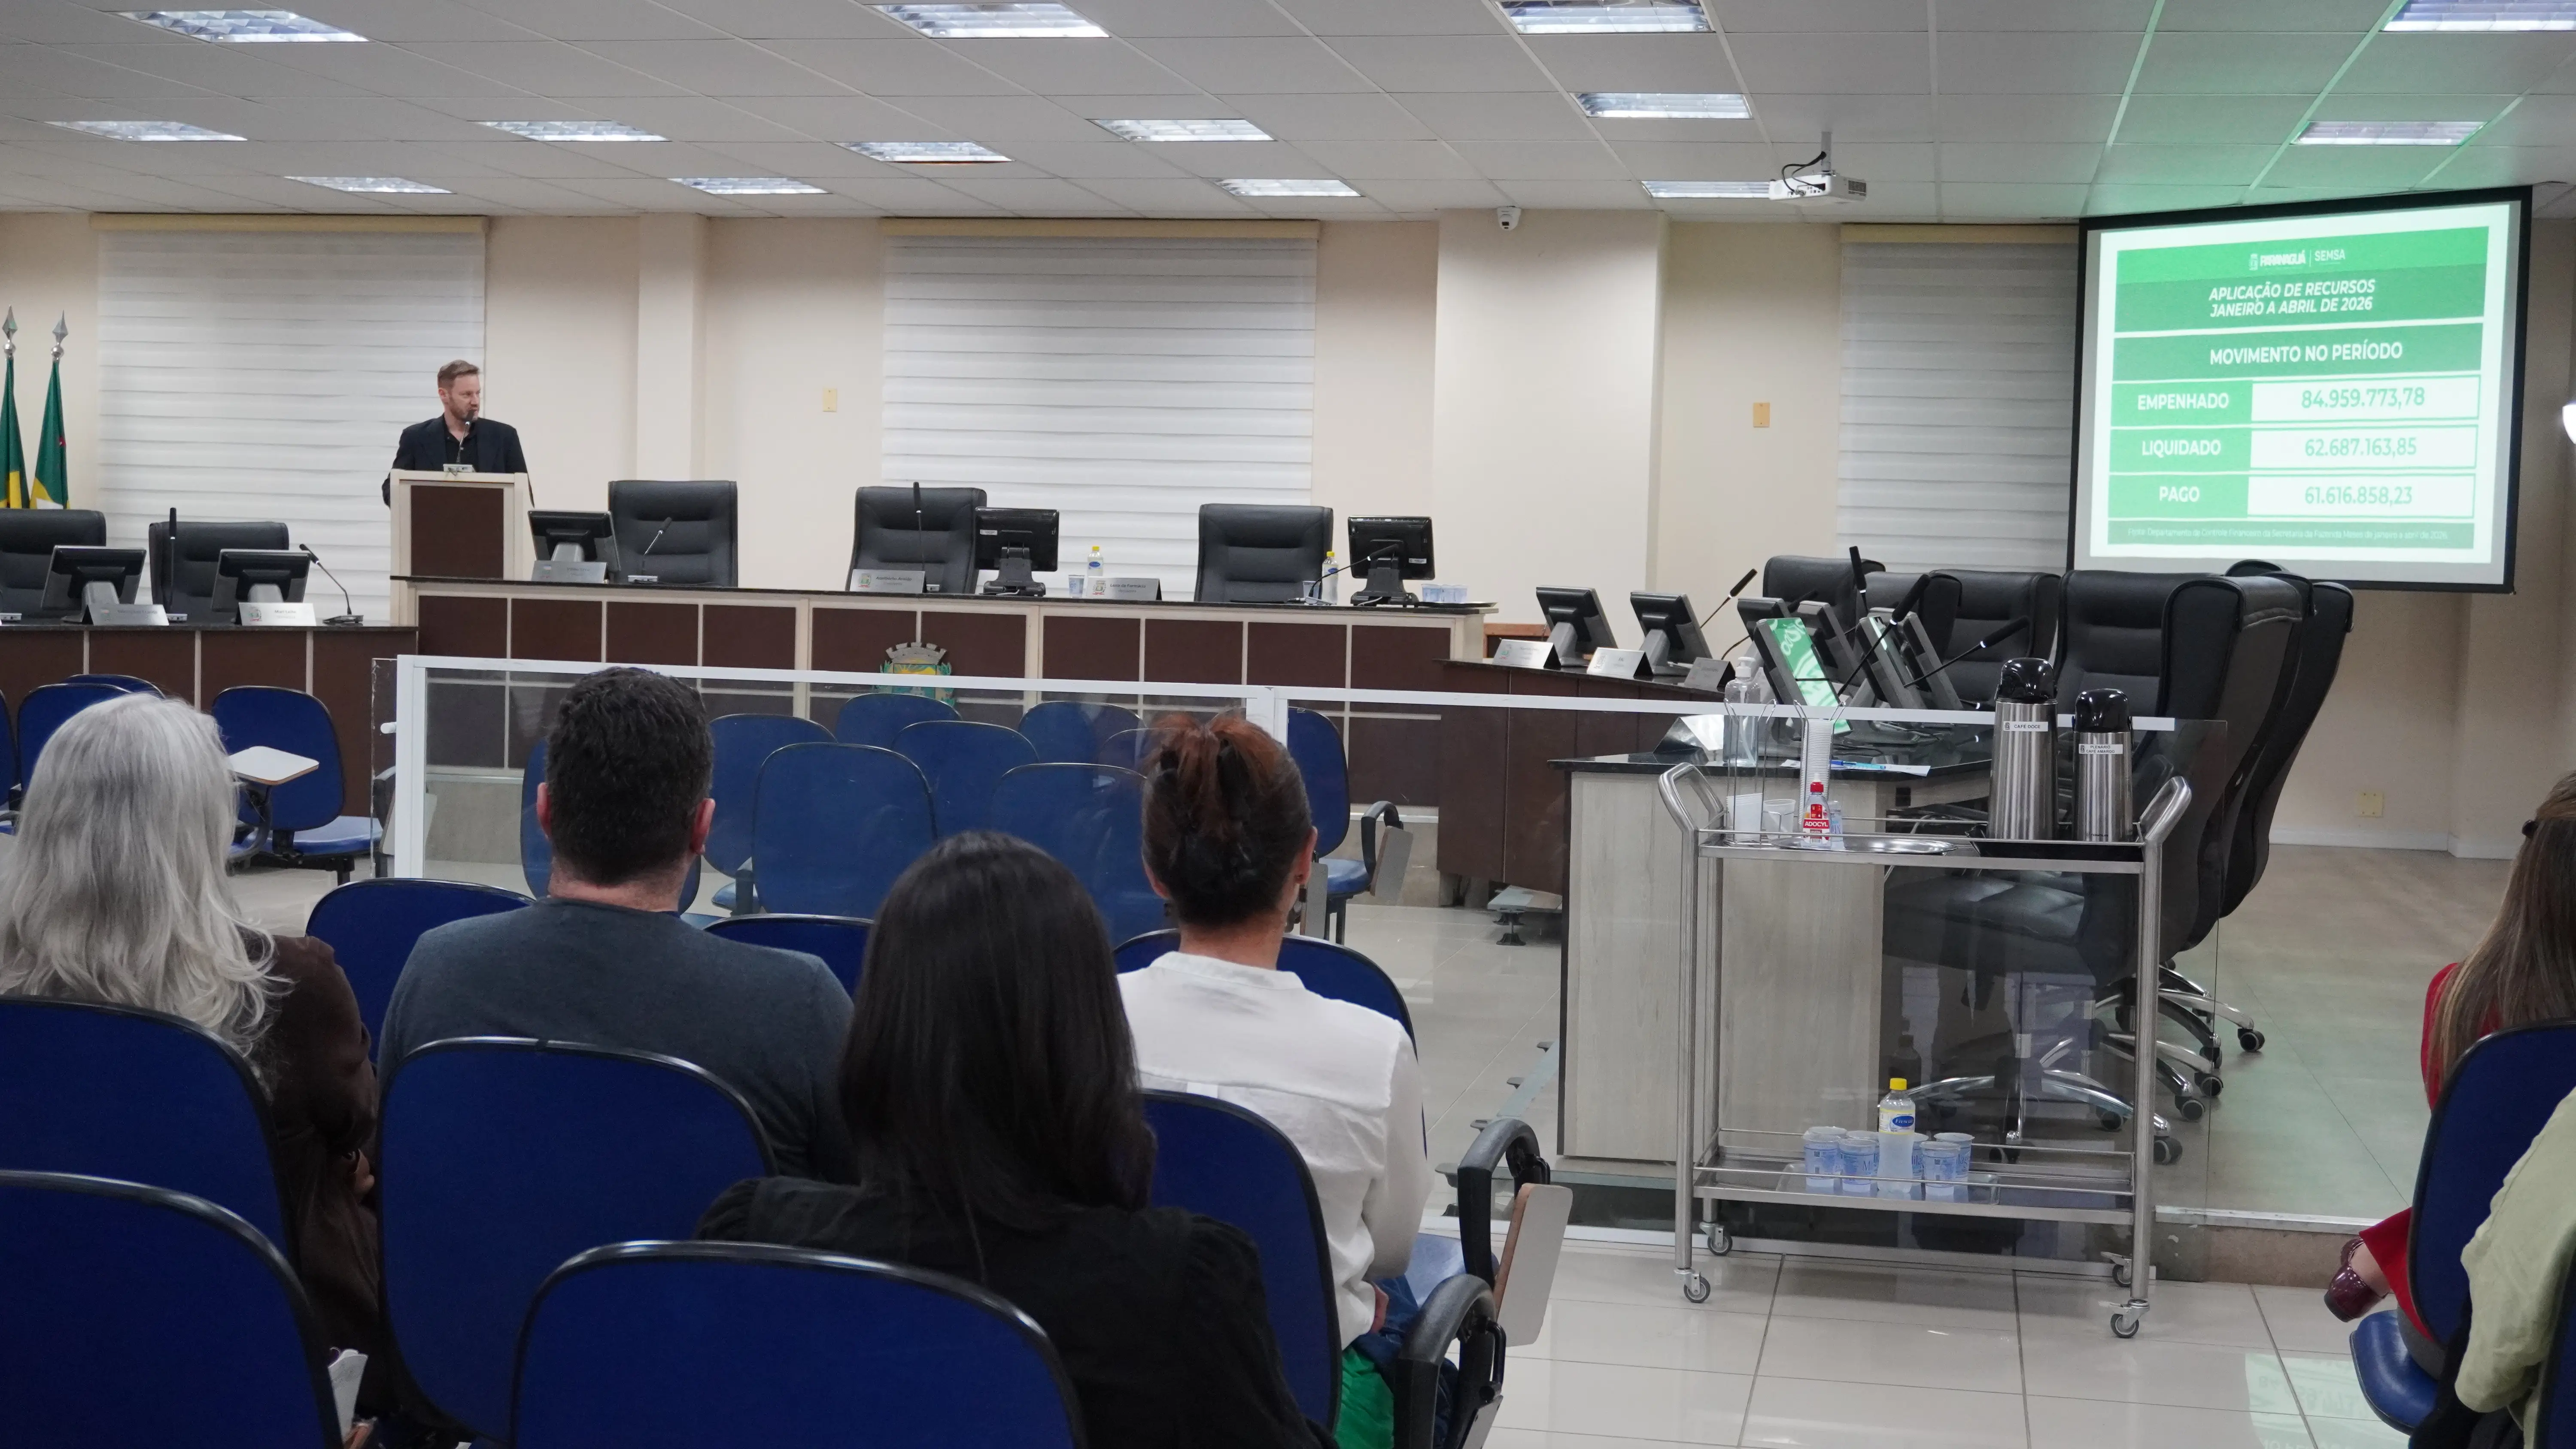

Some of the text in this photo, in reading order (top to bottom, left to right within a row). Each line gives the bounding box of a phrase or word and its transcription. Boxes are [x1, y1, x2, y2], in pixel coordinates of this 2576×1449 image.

[2315, 249, 2345, 261] SEMSA
[2209, 279, 2376, 300] APLICAÇÃO DE RECURSOS
[2210, 296, 2373, 317] JANEIRO A ABRIL DE 2026
[2210, 339, 2403, 365] MOVIMENTO NO PERÍODO
[2138, 387, 2425, 410] EMPENHADO 84.959.773,78
[2142, 437, 2417, 458] LIQUIDADO 62.687.163,85
[2159, 486, 2412, 507] PAGO 61.616.858,23
